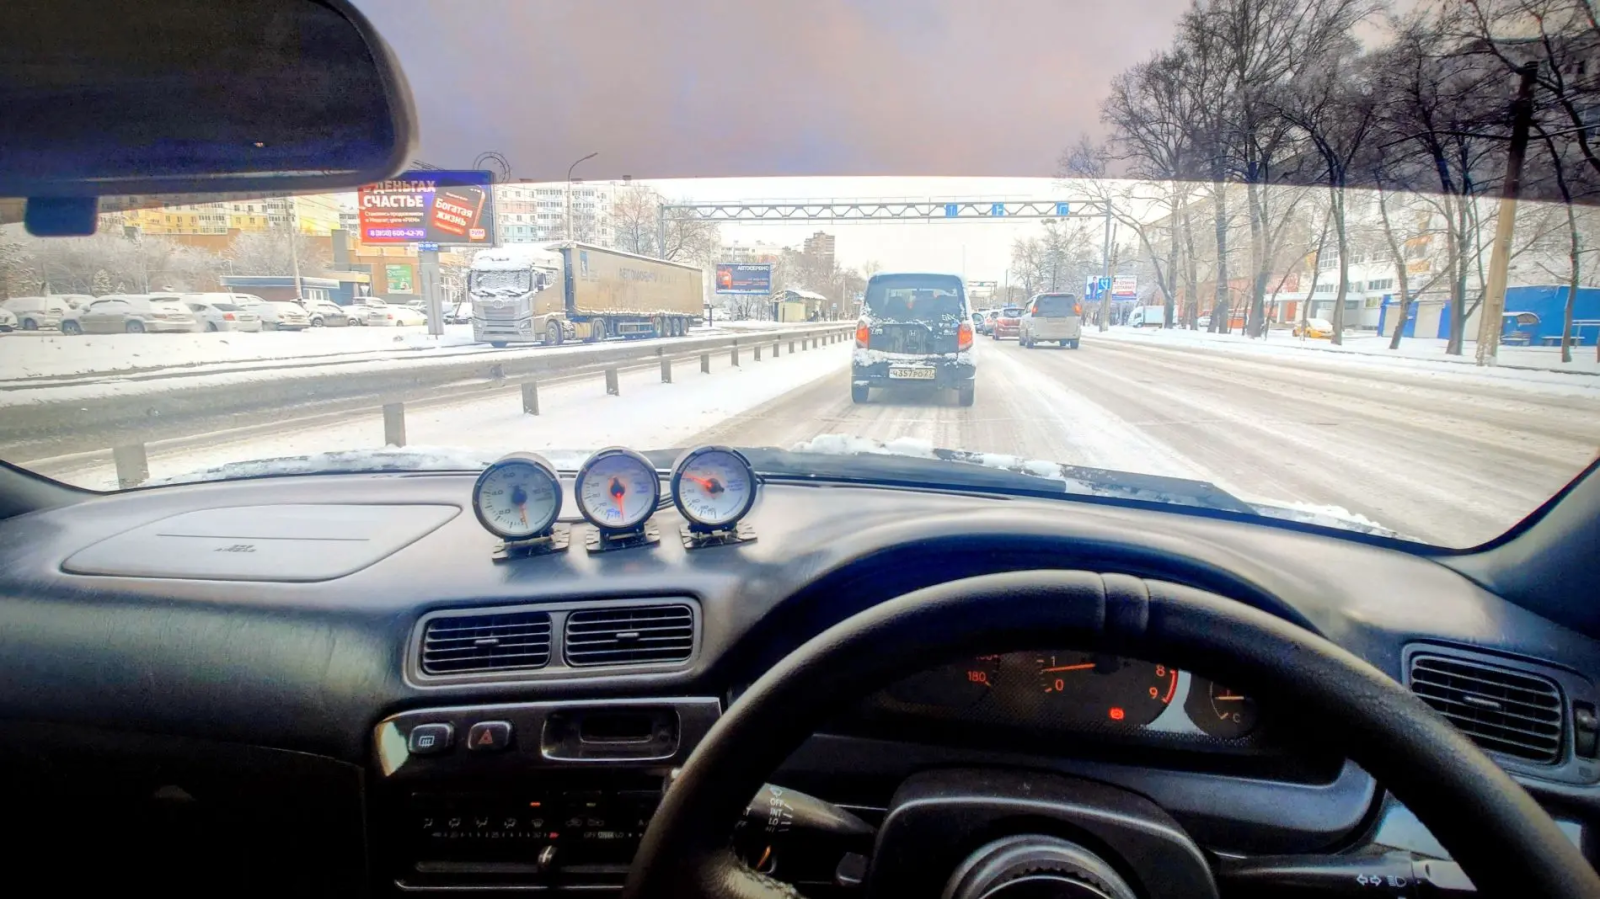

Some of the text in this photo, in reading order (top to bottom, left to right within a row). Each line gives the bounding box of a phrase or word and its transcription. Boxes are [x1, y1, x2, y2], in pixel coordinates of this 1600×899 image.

[373, 180, 436, 194] ДЕНЬГАХ
[363, 195, 424, 208] СЧАСТЬЕ
[435, 197, 473, 218] Богатая
[436, 211, 467, 227] жизнь
[967, 670, 987, 682] 180
[1155, 664, 1165, 677] 8
[1055, 679, 1064, 691] 0
[1149, 687, 1158, 699] 9
[770, 797, 784, 807] OFF
[769, 808, 783, 817] INT
[768, 817, 779, 826] LO
